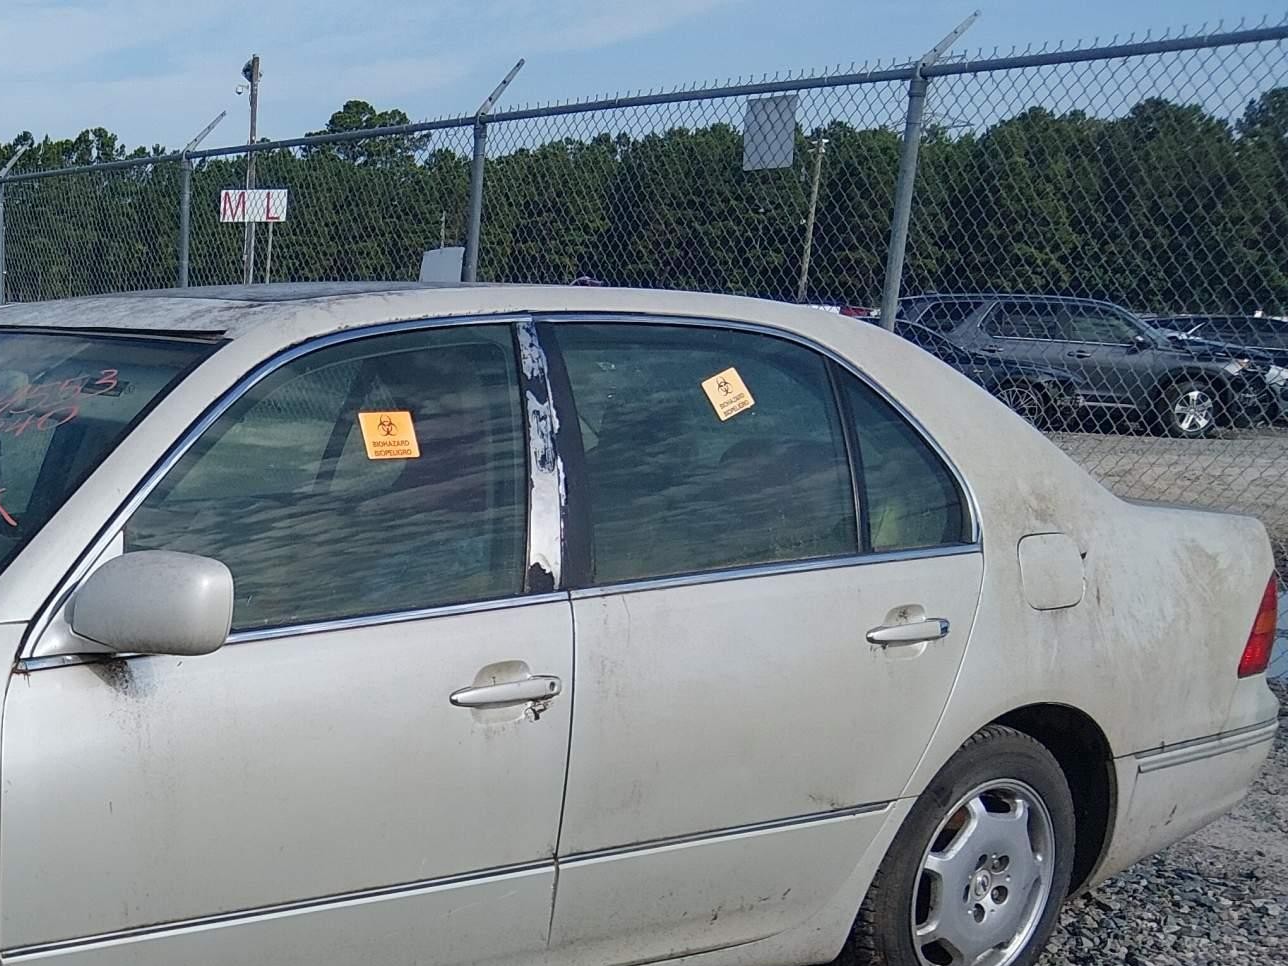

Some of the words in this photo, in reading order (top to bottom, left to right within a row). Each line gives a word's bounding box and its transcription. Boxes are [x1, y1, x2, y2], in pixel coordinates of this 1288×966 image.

[222, 191, 246, 221] M
[266, 191, 281, 221] L
[372, 440, 410, 448] BIOHAZARD
[374, 449, 412, 457] BIOPELIGRO
